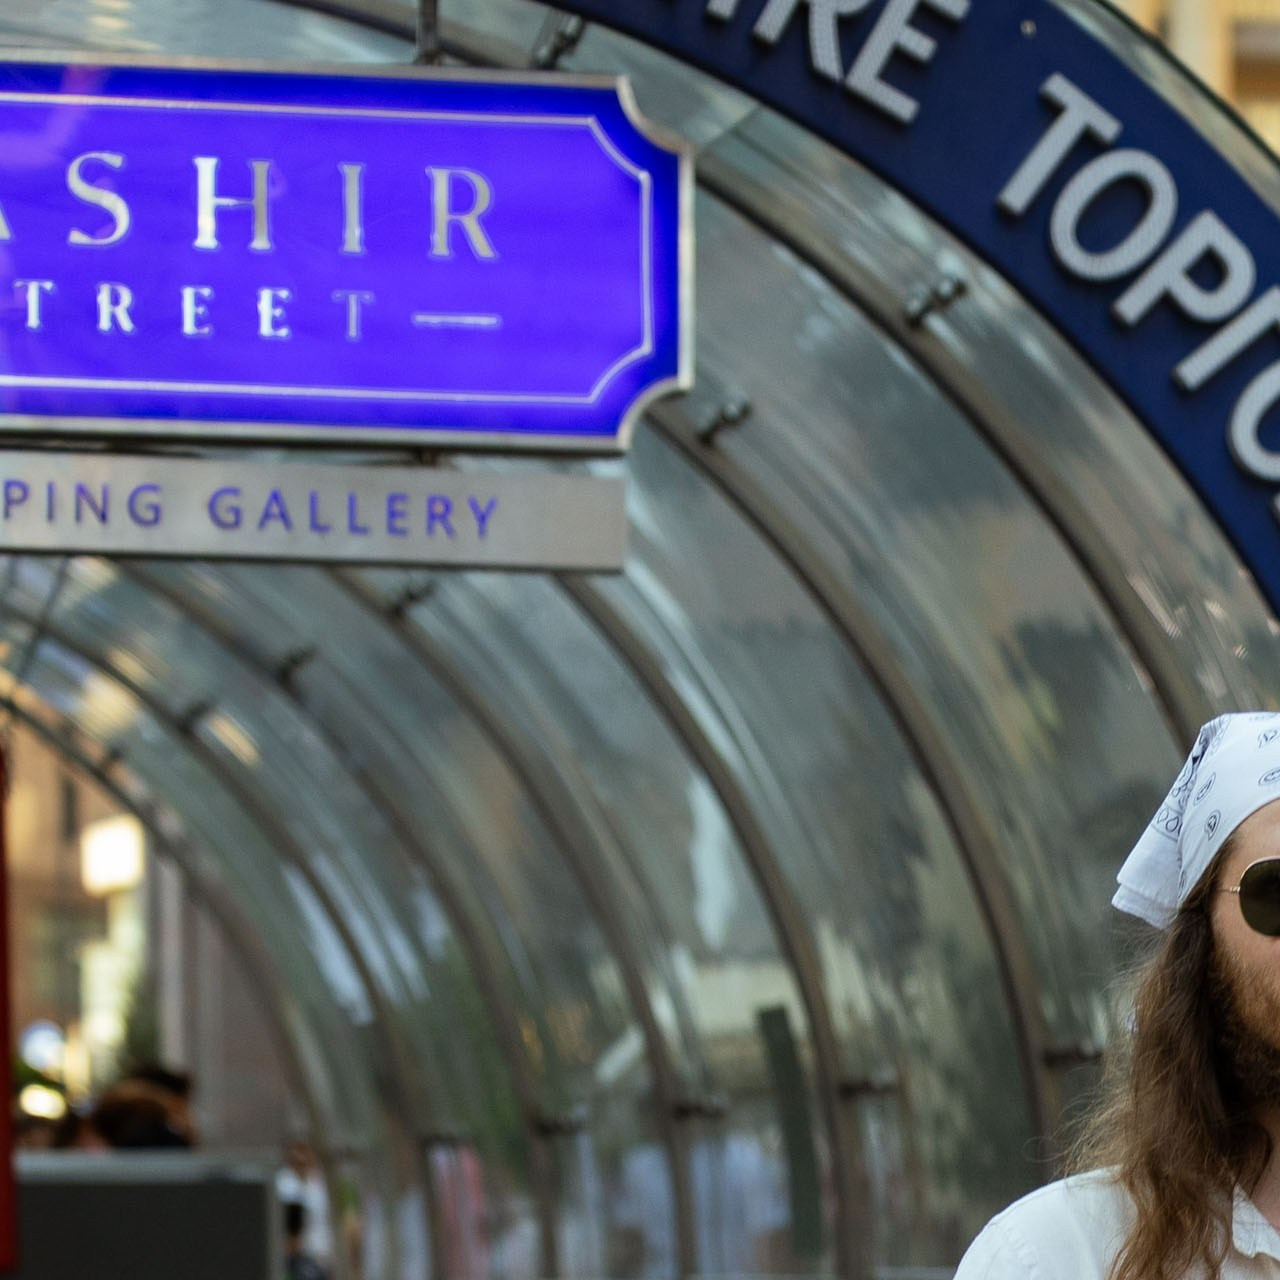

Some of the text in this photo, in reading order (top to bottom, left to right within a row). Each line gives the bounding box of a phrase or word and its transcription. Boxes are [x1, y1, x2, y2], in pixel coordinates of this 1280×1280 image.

[0, 151, 498, 260] SHIR
[1, 480, 499, 538] PING GALLERY
